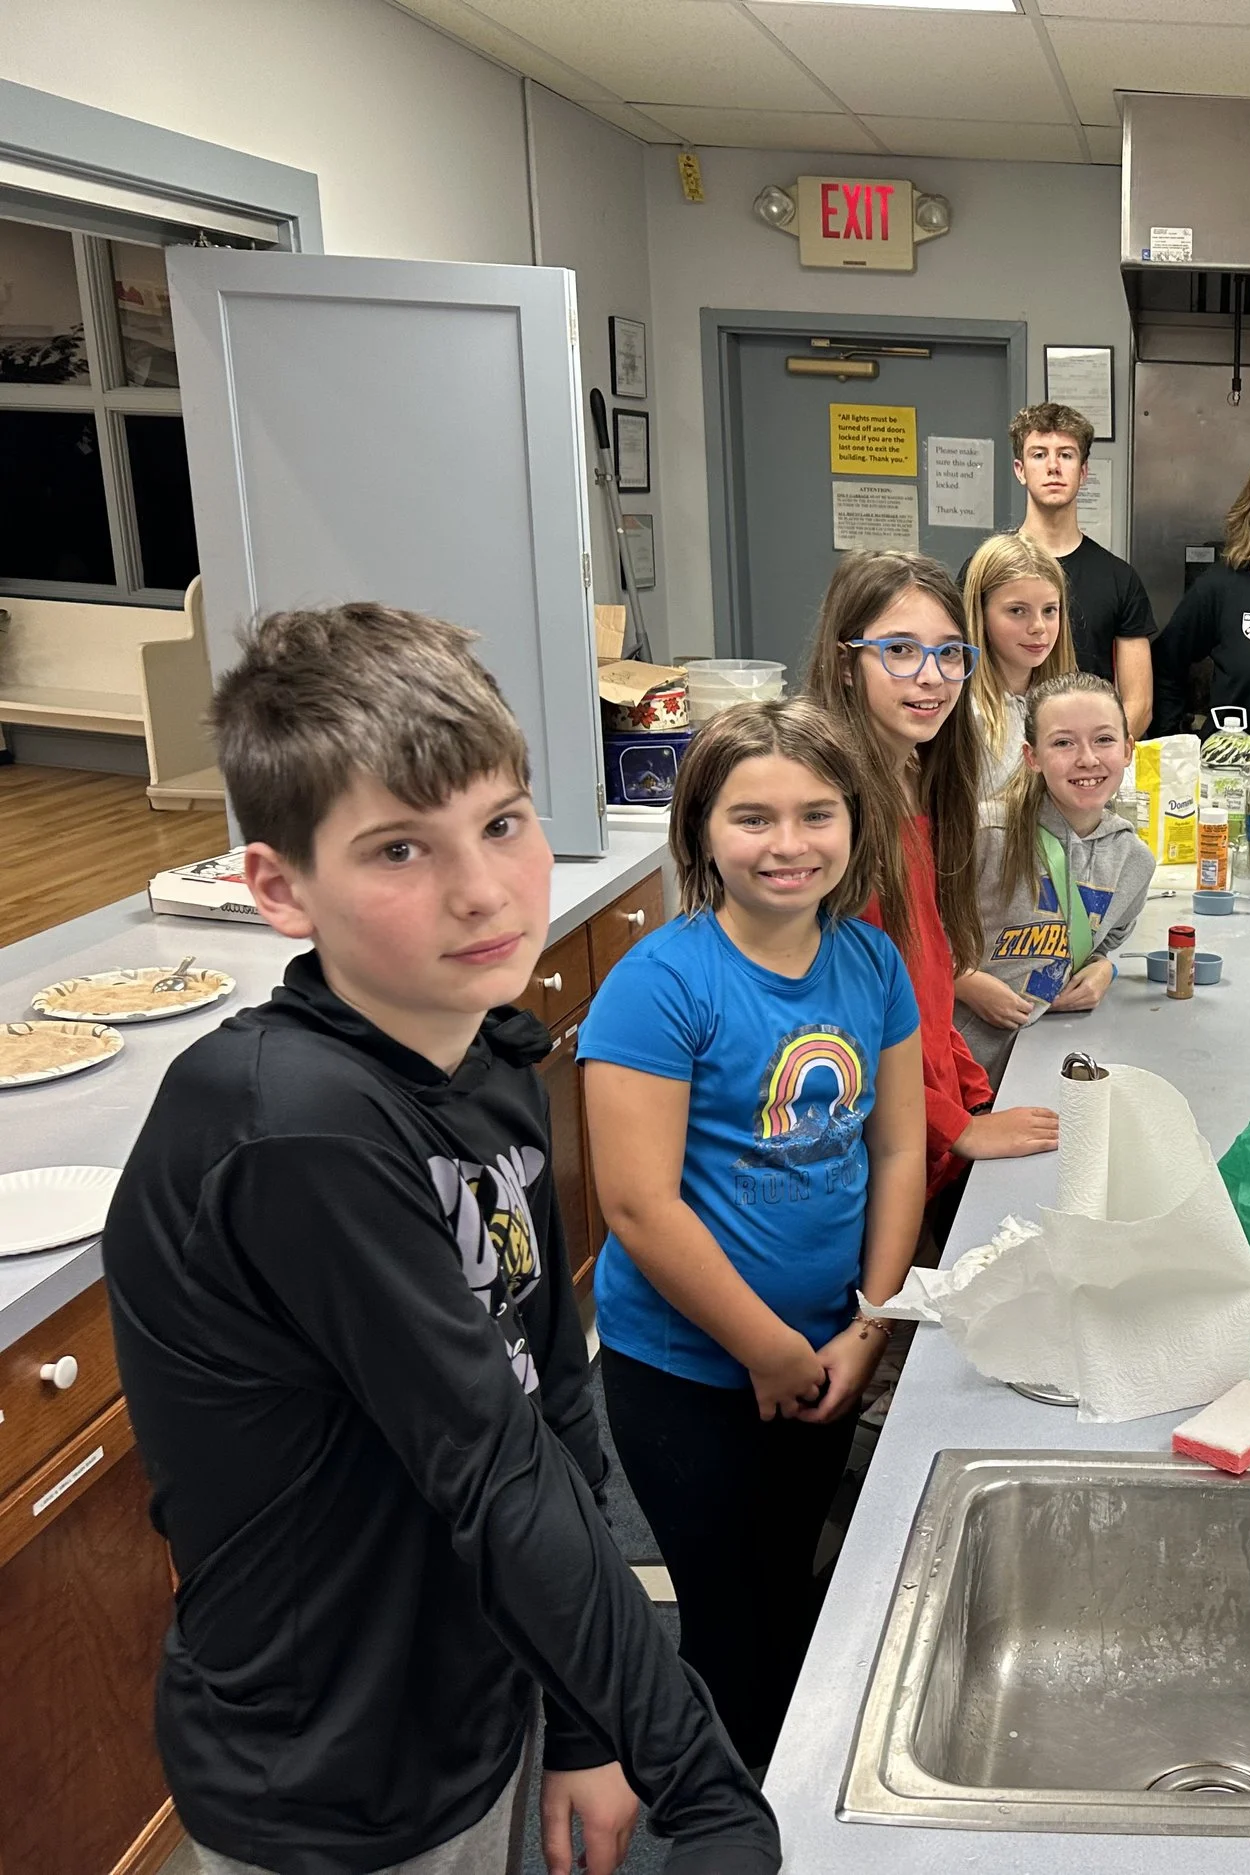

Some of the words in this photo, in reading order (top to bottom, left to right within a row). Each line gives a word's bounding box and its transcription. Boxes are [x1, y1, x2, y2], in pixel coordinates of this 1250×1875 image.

[821, 183, 894, 240] EXIT
[851, 414, 870, 423] lights
[873, 425, 885, 433] and
[861, 434, 867, 442] if
[867, 436, 880, 444] you
[838, 443, 851, 451] last
[936, 446, 958, 454] Please
[959, 447, 978, 455] make
[839, 454, 868, 463] building.
[869, 454, 889, 462] Thank
[952, 459, 966, 467] this
[966, 460, 983, 468] door
[943, 470, 959, 478] shut
[960, 470, 974, 478] and
[936, 505, 958, 514] Thank
[735, 1170, 810, 1206] RUN
